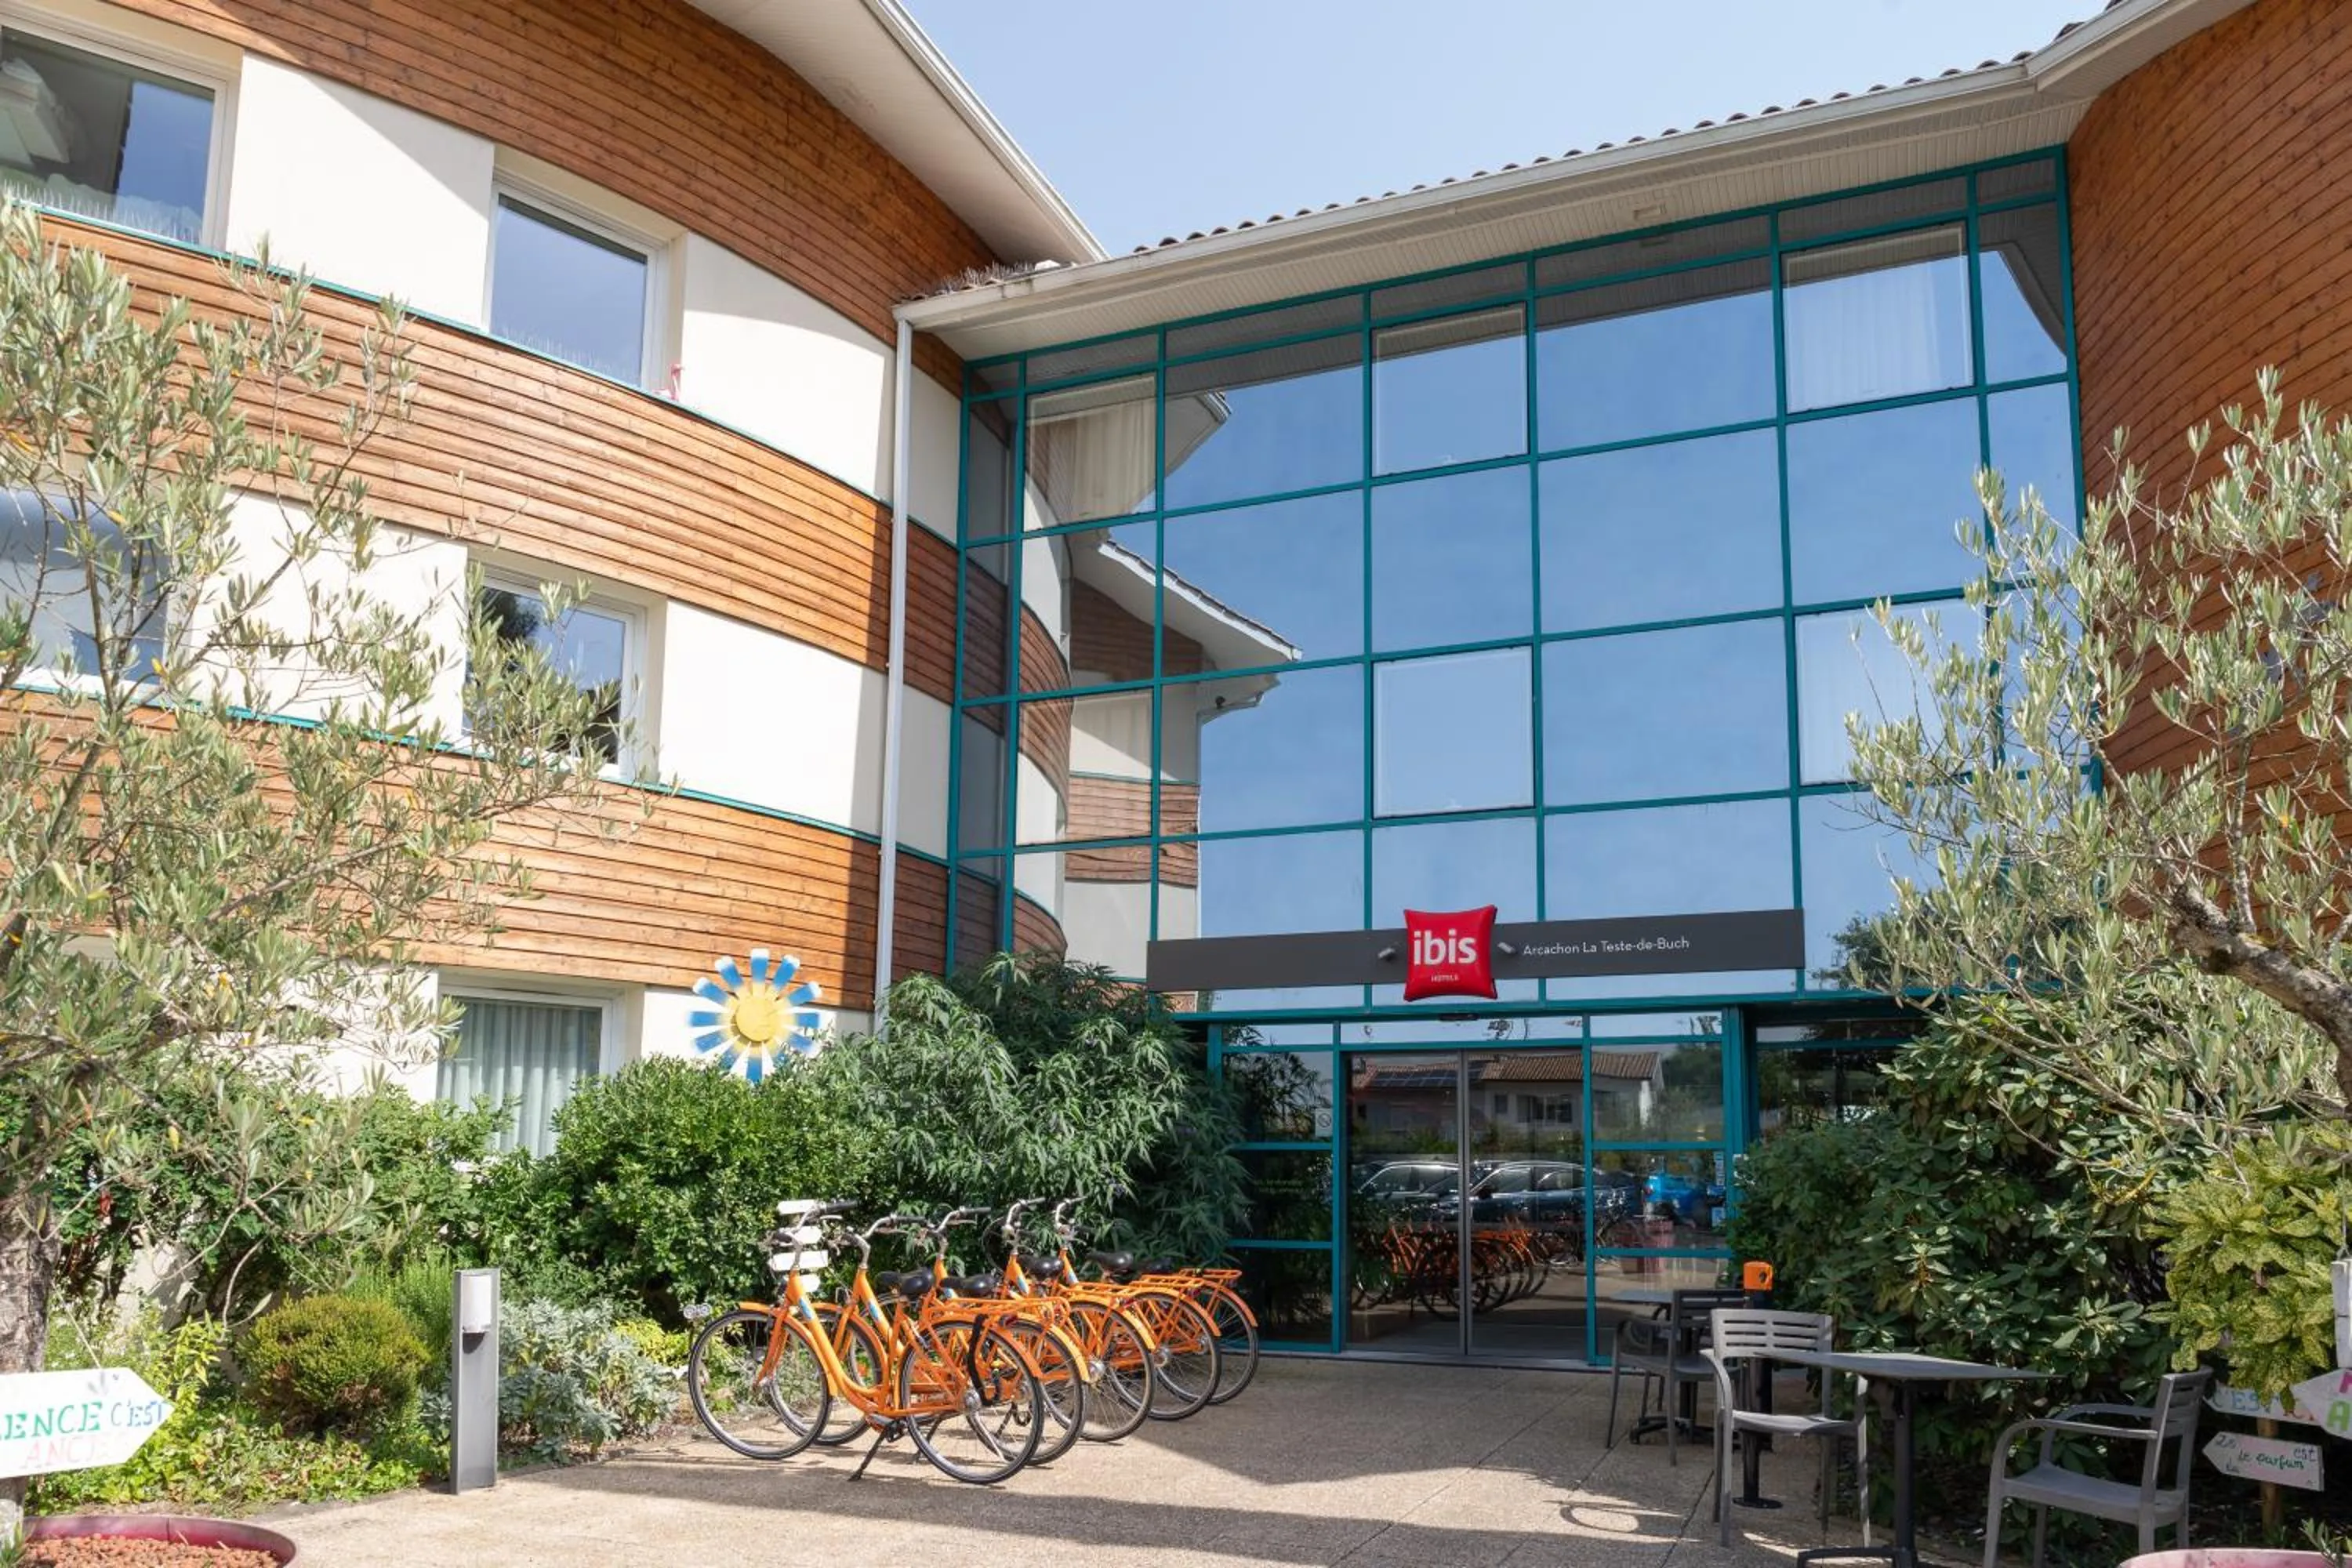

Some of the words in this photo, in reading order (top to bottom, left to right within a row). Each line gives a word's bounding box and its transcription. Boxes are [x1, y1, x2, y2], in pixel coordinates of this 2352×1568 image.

[1414, 928, 1477, 966] ibis
[1523, 942, 1580, 956] Arcachon
[1583, 941, 1597, 953] La
[1600, 936, 1690, 953] Teste-de-Buch
[0, 1401, 103, 1440] ENCE
